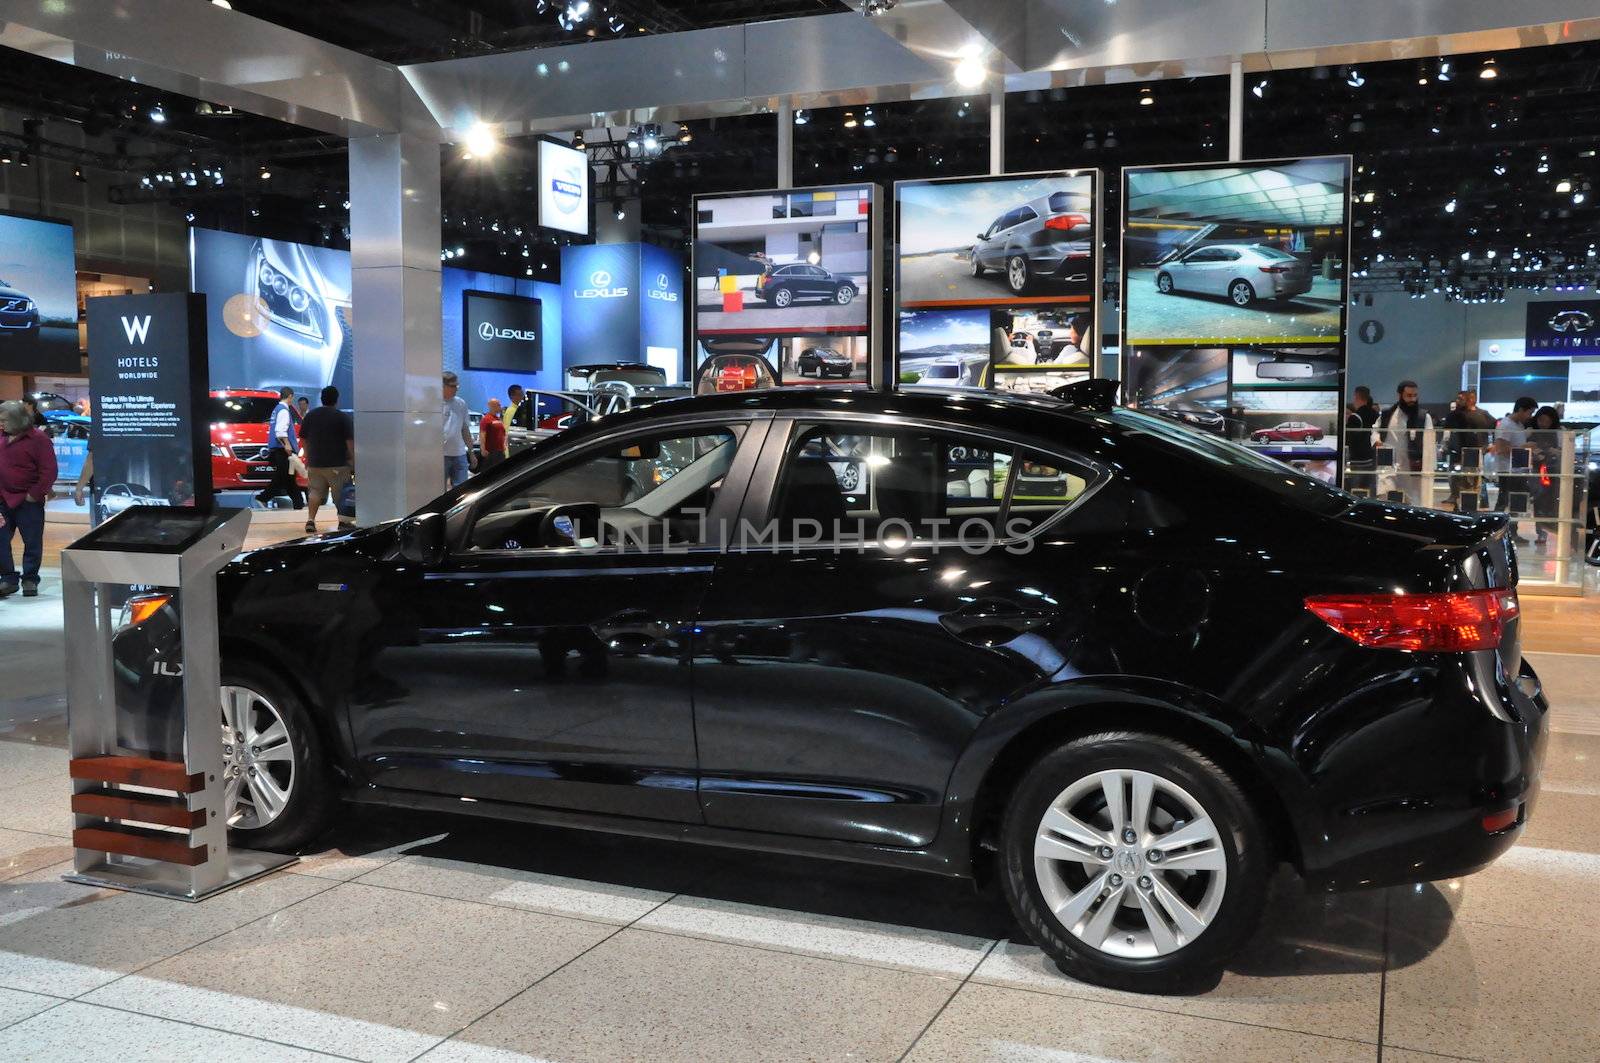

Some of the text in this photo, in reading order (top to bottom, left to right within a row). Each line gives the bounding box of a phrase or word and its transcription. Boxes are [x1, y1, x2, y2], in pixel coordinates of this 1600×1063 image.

[574, 287, 629, 299] LEXUS
[648, 289, 677, 302] LEXUS
[121, 315, 151, 344] W
[495, 328, 535, 340] LEXUS
[118, 357, 158, 367] HOTELS
[151, 402, 176, 410] Experience
